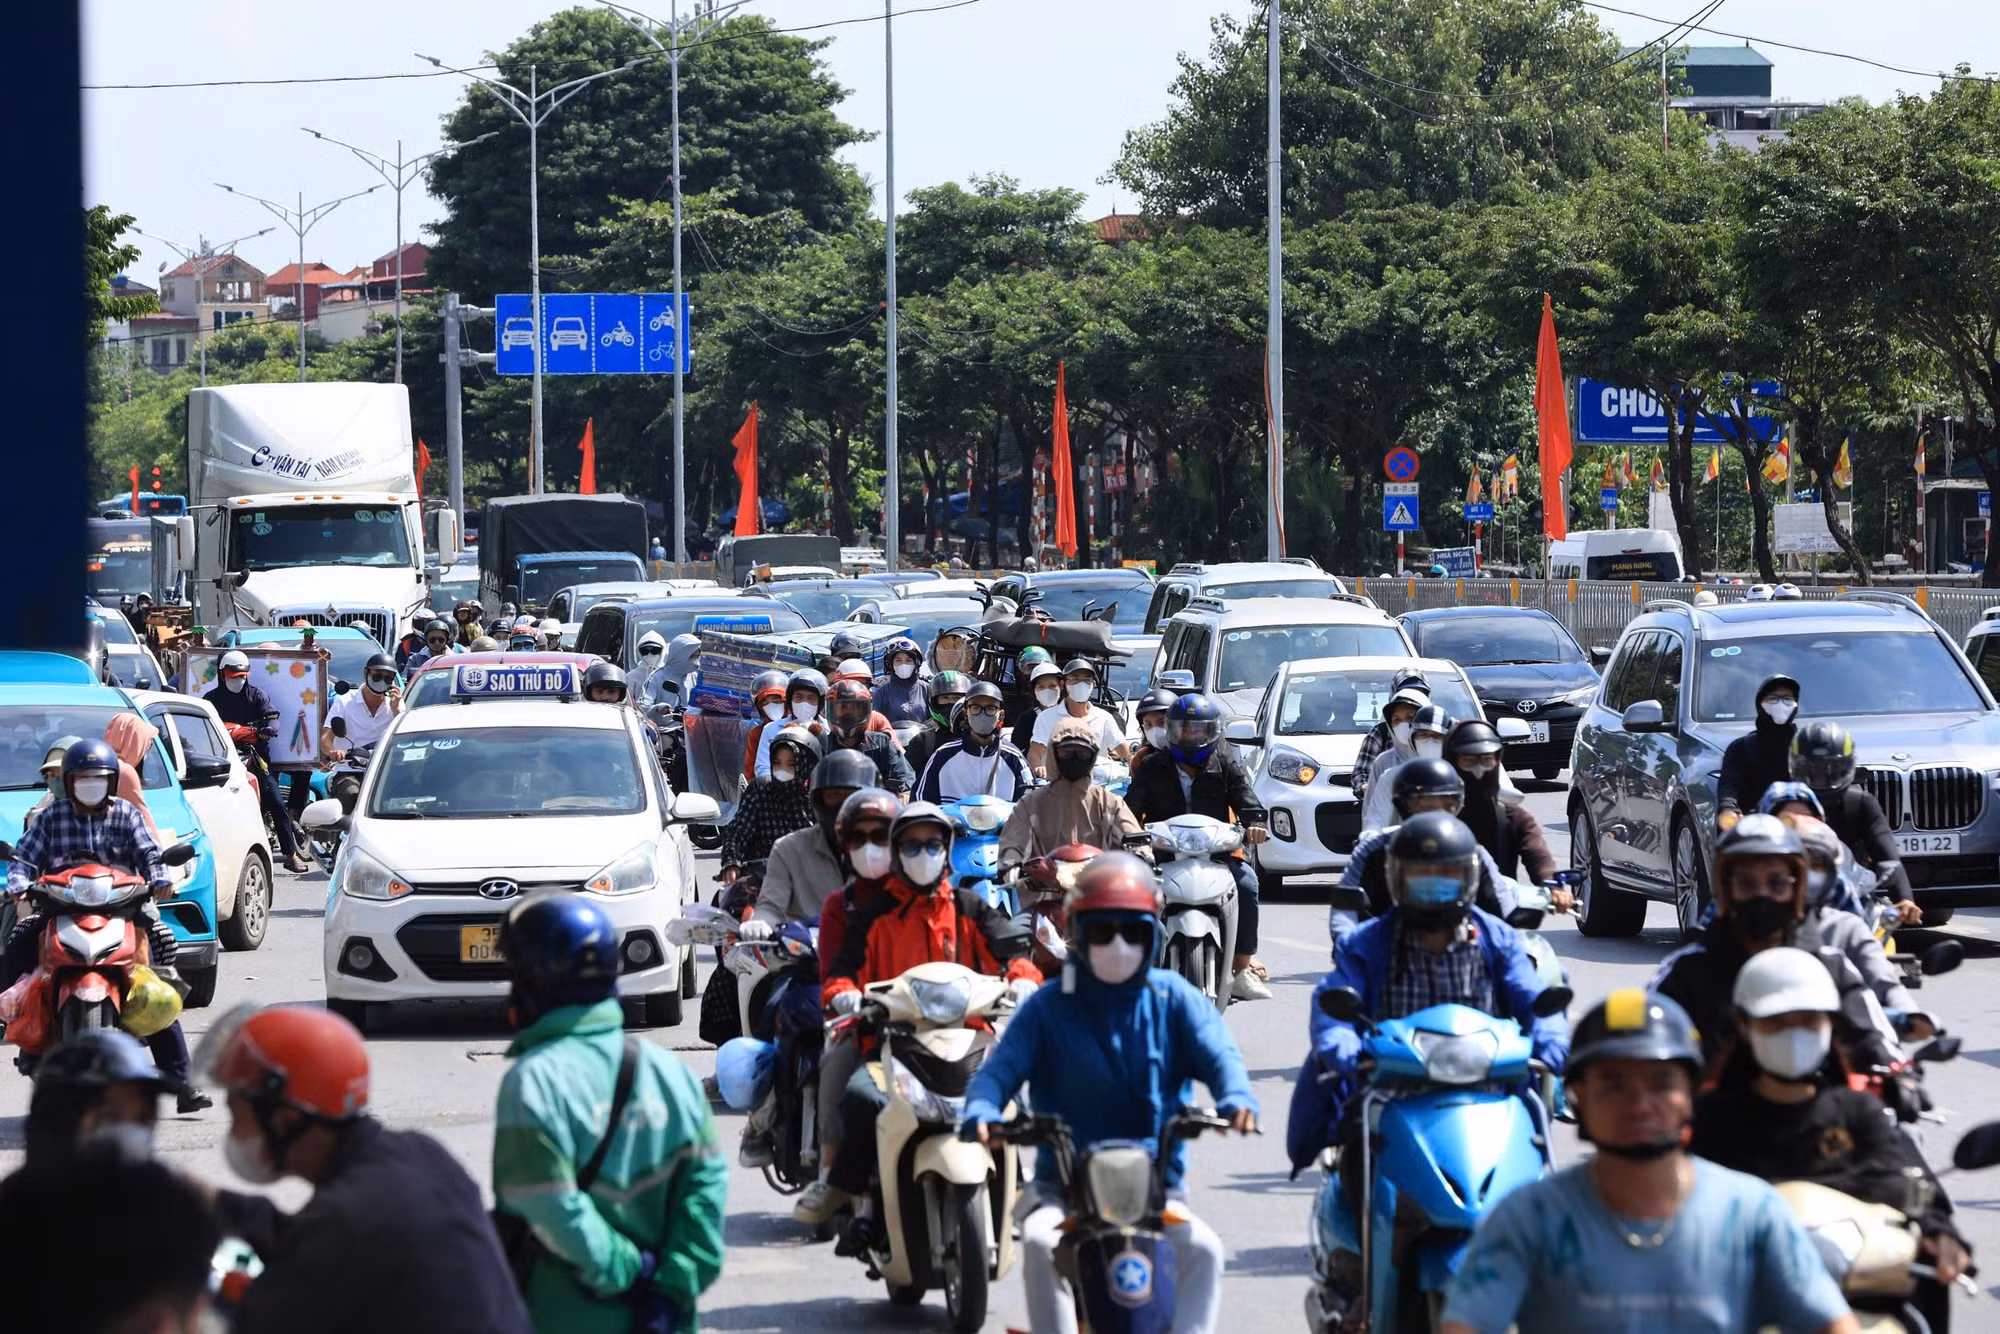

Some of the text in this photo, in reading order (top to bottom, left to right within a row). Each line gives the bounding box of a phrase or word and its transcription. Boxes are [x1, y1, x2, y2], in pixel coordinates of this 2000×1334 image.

[314, 457, 340, 478] NAM
[357, 511, 371, 520] VN
[378, 511, 393, 520] VN
[256, 524, 271, 533] VN
[754, 623, 771, 632] TAXI
[490, 668, 563, 691] SAO THỦ ĐÔ
